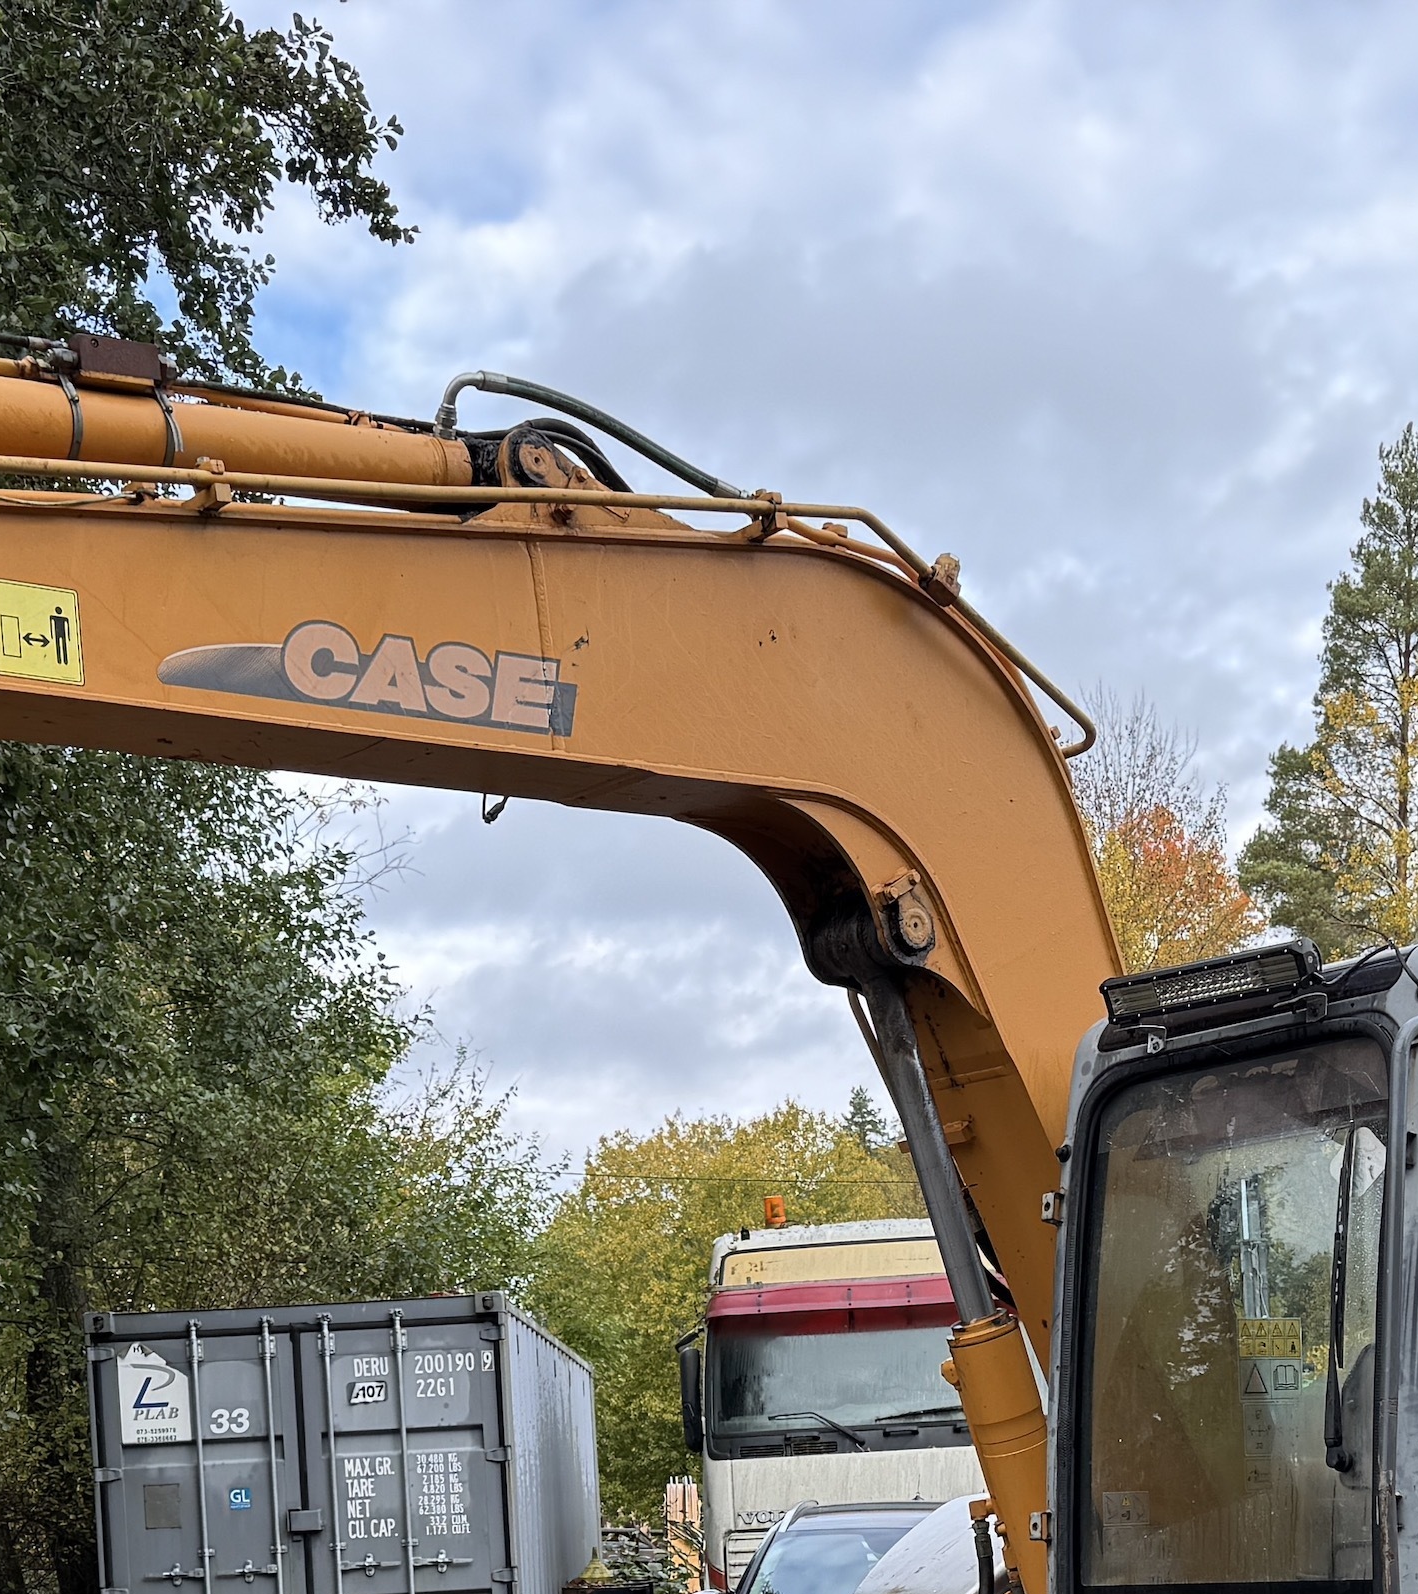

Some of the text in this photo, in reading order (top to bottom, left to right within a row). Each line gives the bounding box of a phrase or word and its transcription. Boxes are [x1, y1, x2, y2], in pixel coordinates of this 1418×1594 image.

[282, 619, 561, 733] CASE
[353, 1351, 493, 1378] DERU 200190 9
[416, 1377, 455, 1398] 22G1
[133, 1407, 180, 1421] PLAB
[209, 1407, 250, 1434] 33
[230, 1489, 250, 1503] GL
[346, 1478, 376, 1498] TARE
[347, 1499, 371, 1519] NET
[348, 1518, 399, 1539] CU. CAP.
